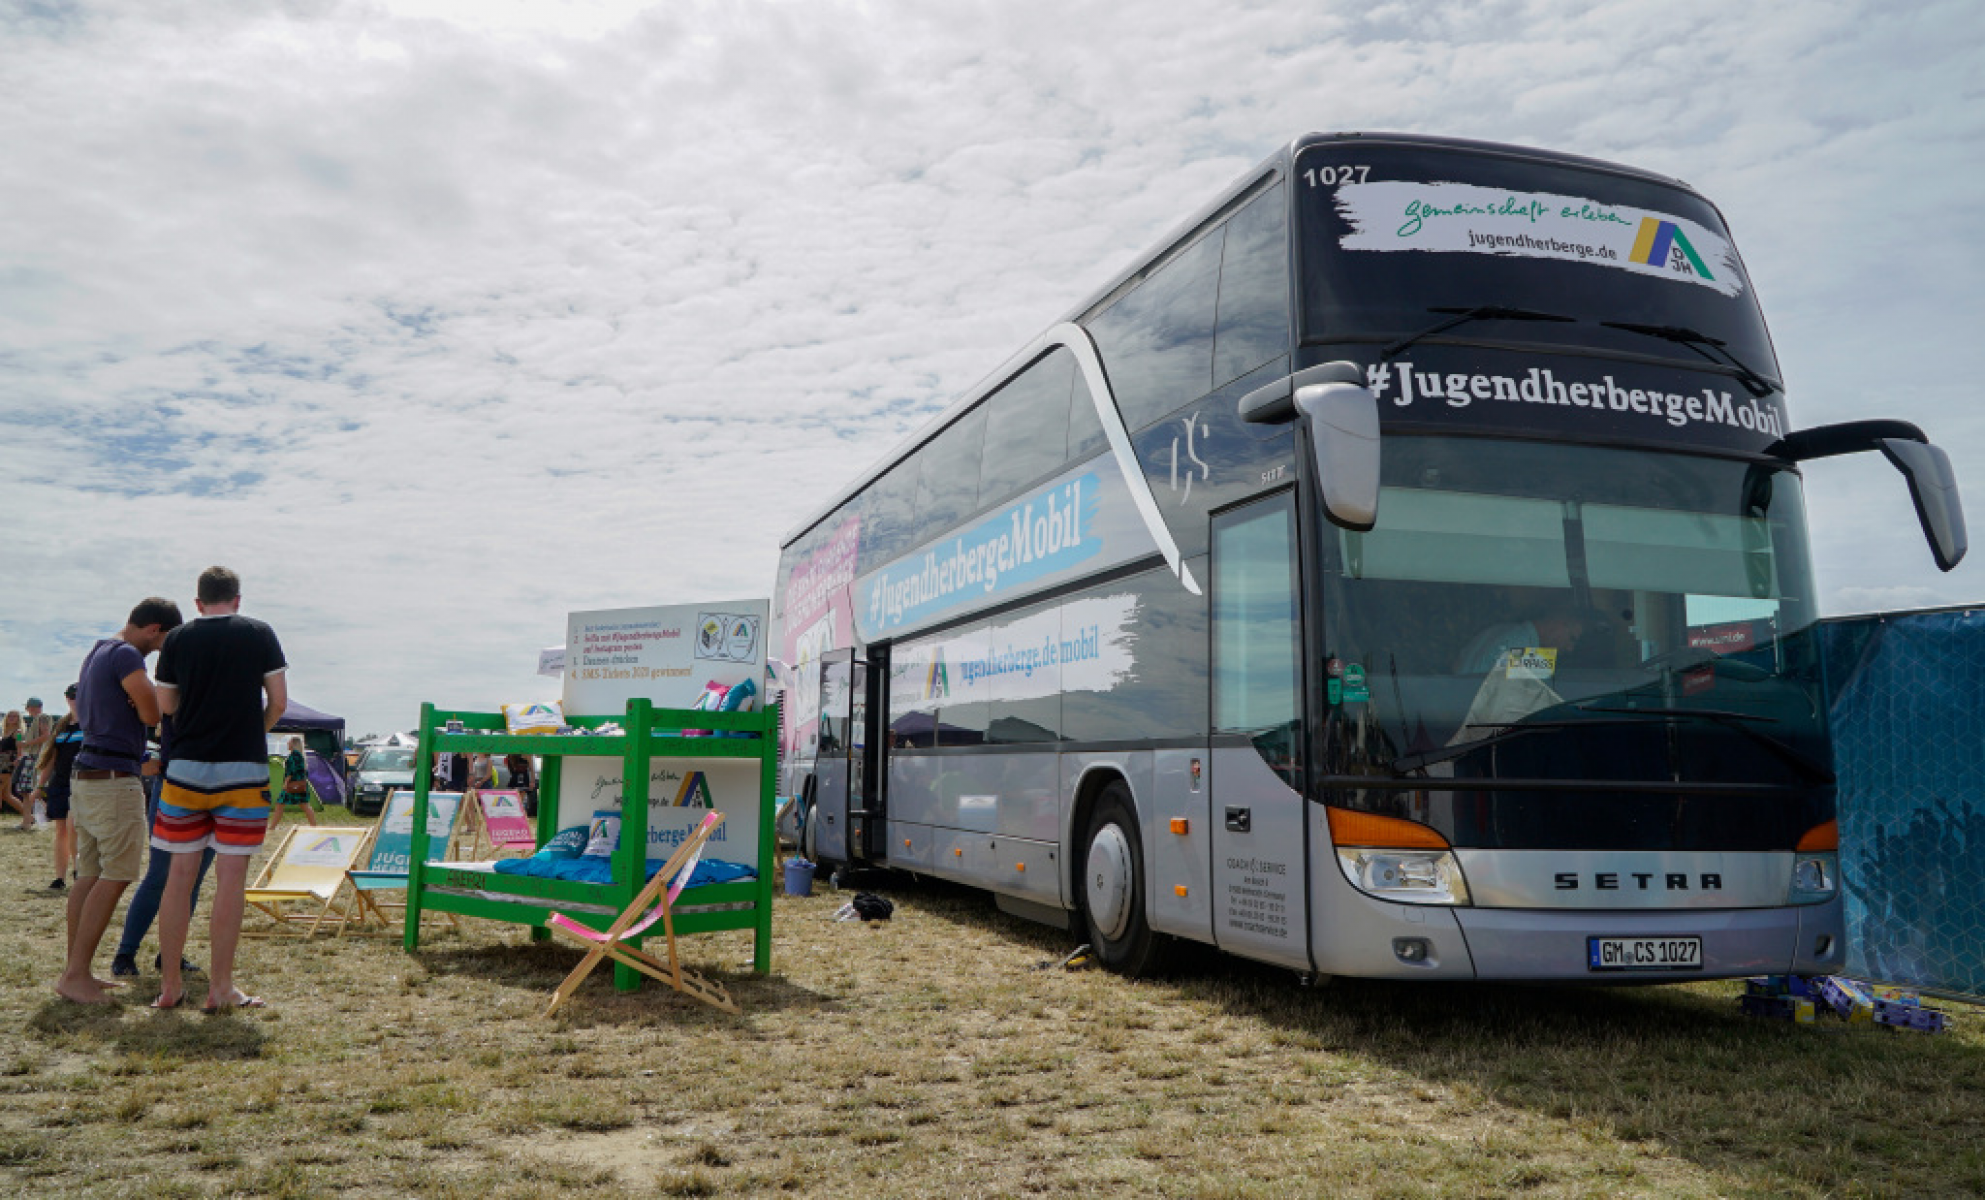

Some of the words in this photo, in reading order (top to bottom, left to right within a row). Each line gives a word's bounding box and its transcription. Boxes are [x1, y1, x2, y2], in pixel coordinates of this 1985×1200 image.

[1303, 165, 1371, 187] 1027
[1561, 202, 1632, 225] erleben
[1469, 230, 1618, 260] jugendherberge.de
[1367, 361, 1785, 441] #JugendherbergeMobil
[870, 480, 1082, 630] #JugendherbergeMobil
[1060, 625, 1100, 664] mobil
[1554, 872, 1723, 891] SETRA
[1603, 941, 1623, 963] GM
[1634, 941, 1656, 963] CS
[1659, 941, 1697, 963] 1027
